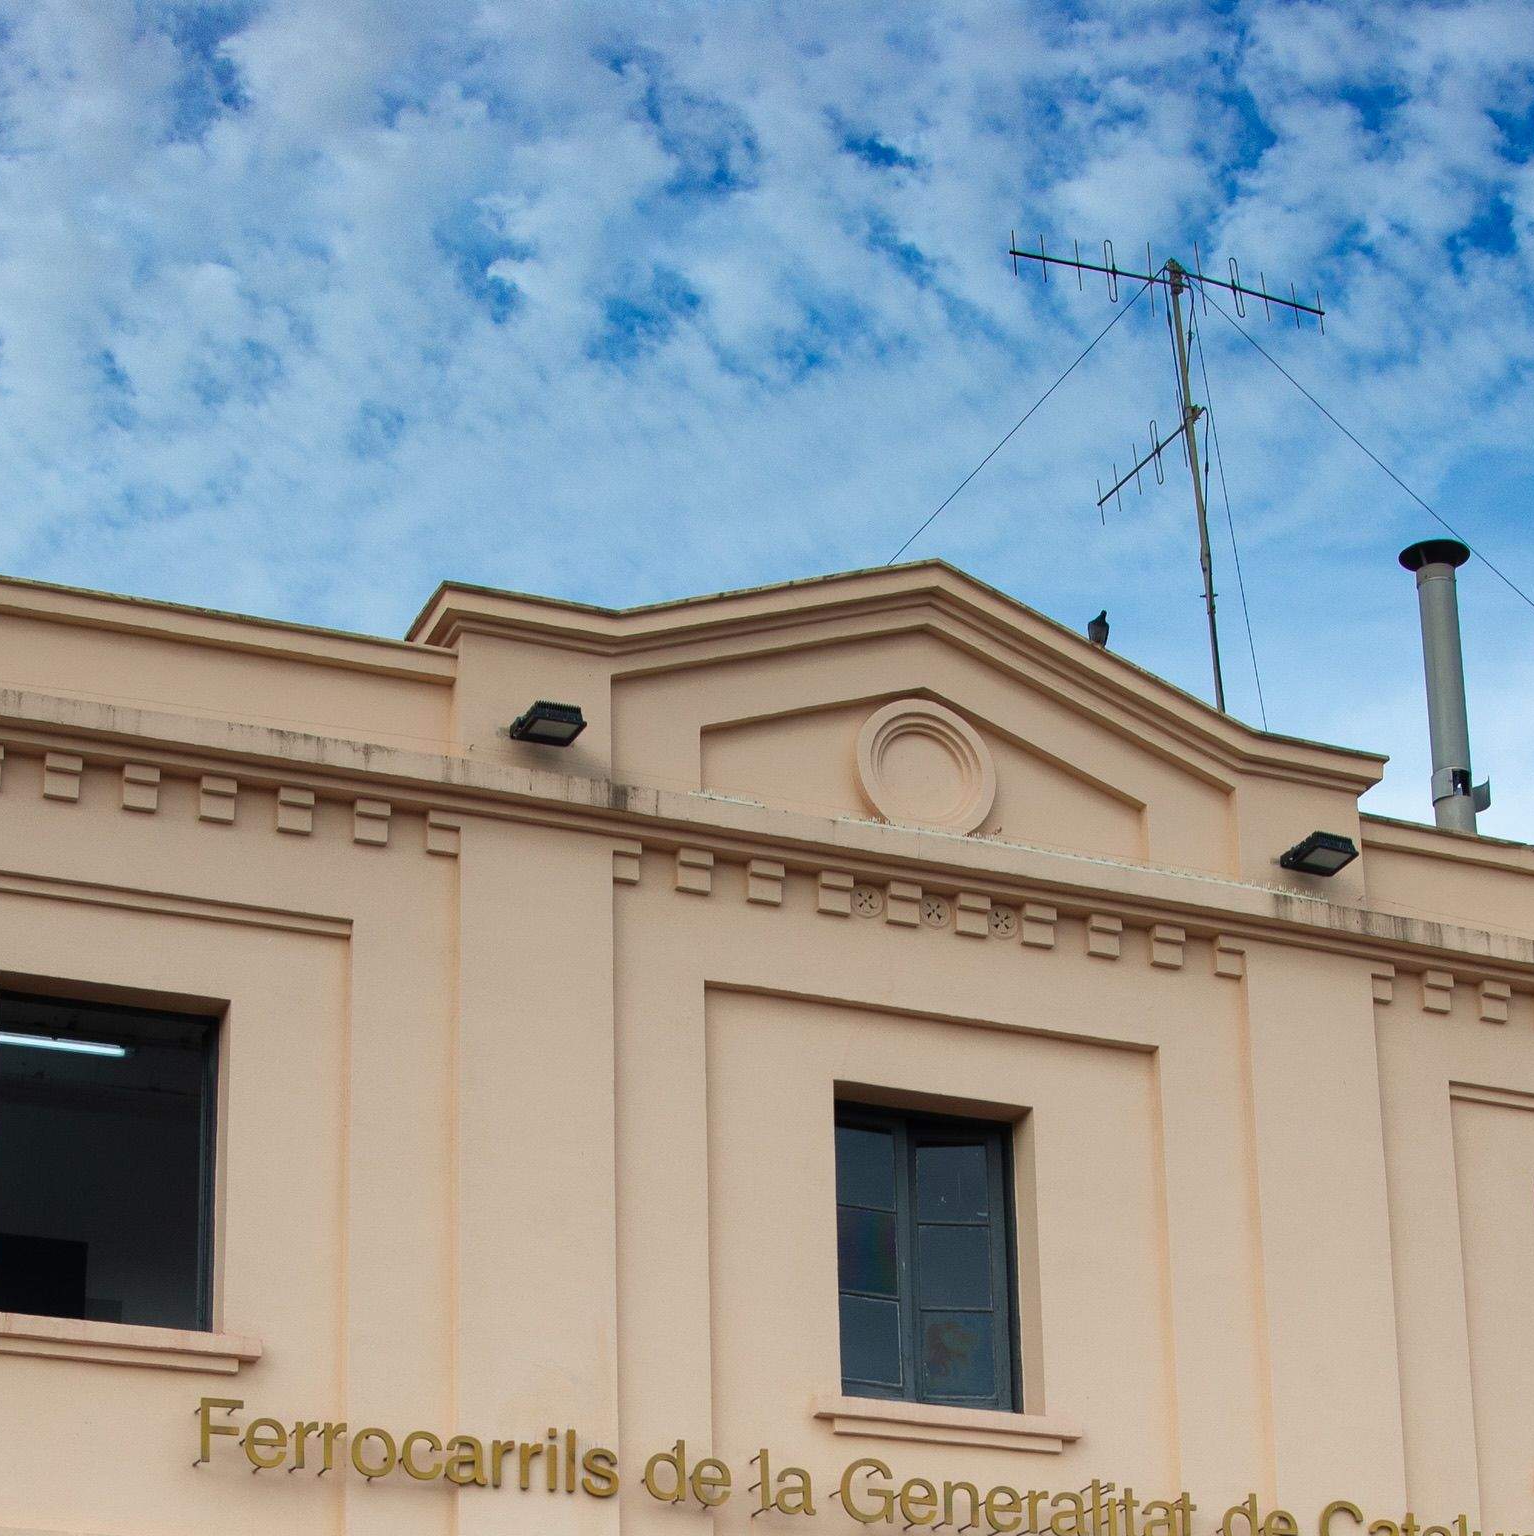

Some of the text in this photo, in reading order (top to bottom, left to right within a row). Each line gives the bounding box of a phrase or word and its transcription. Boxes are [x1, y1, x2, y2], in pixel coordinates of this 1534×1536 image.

[199, 1396, 620, 1499] Ferrocarrils
[644, 1439, 733, 1508] de
[757, 1448, 817, 1516] la
